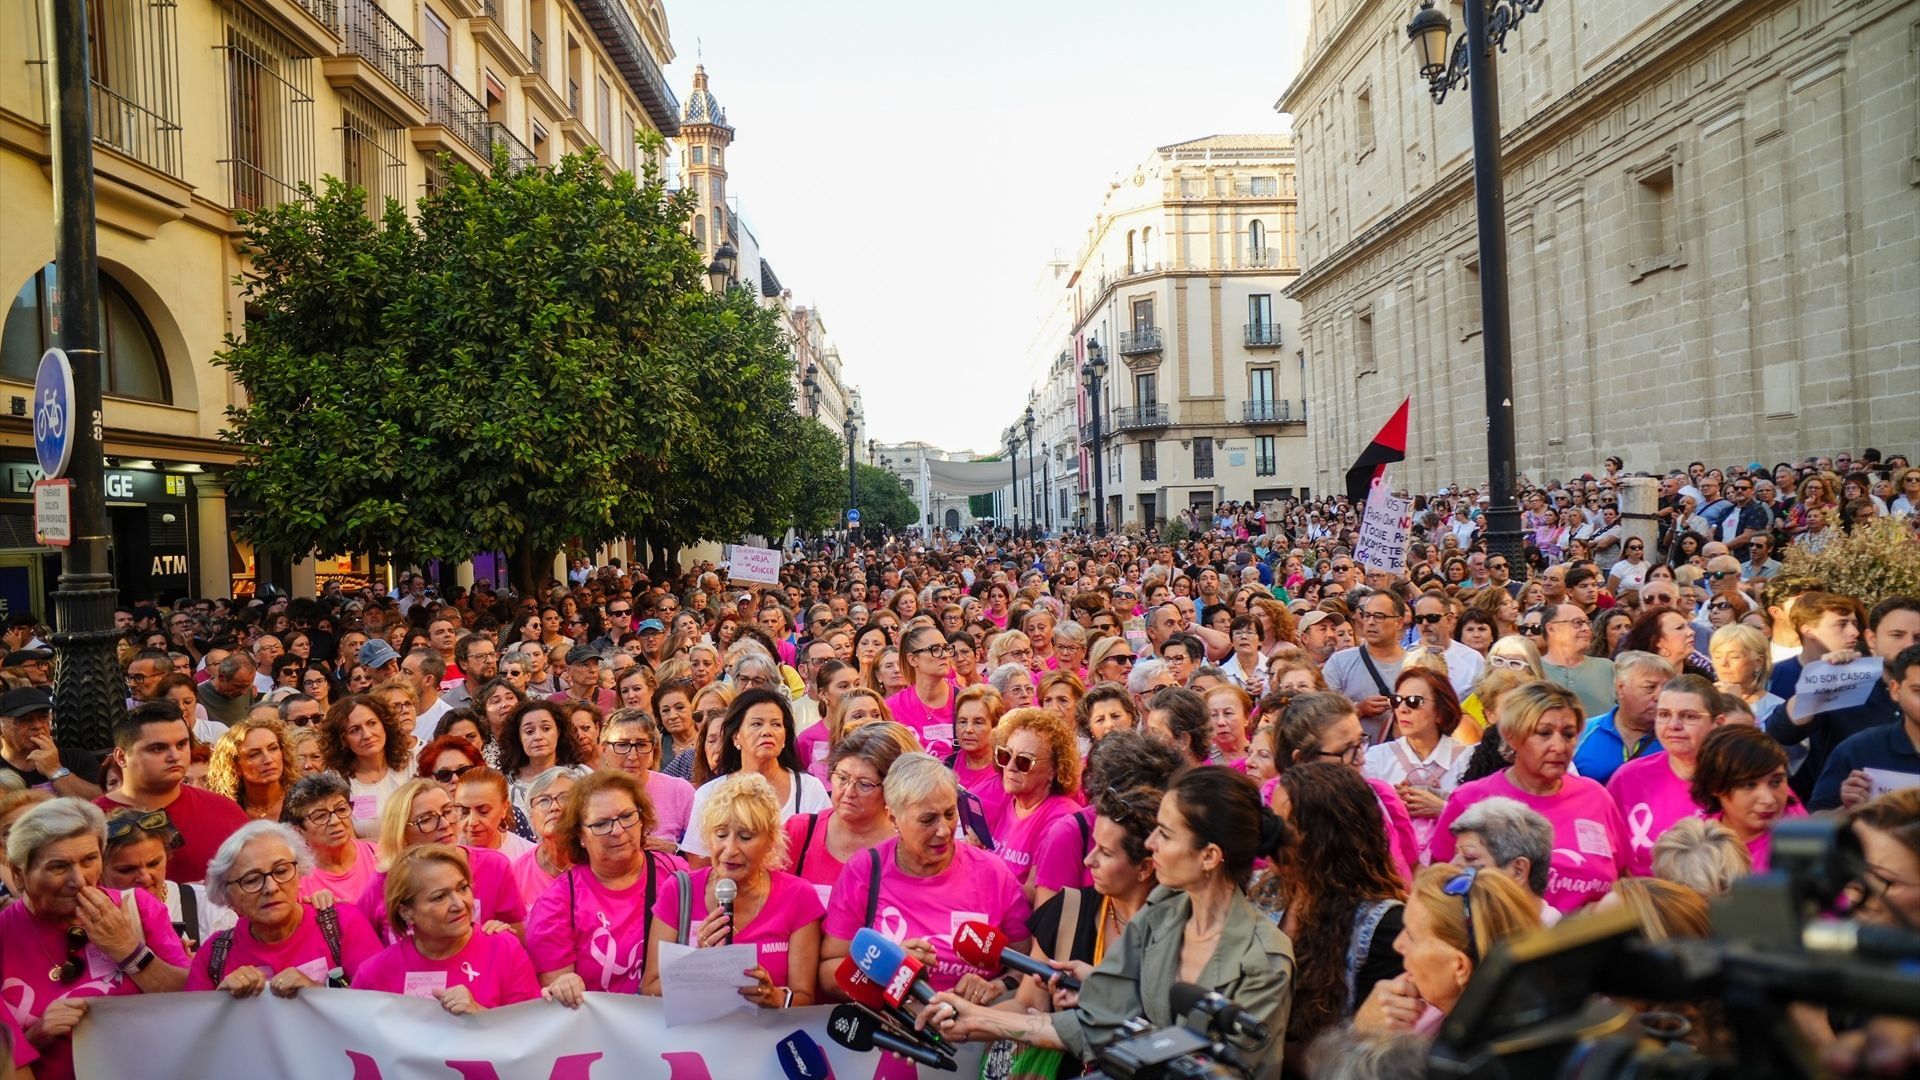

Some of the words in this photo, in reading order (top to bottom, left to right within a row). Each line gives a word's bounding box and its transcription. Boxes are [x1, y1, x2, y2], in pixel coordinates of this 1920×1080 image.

[152, 555, 188, 576] ATM
[1805, 675, 1818, 684] NO
[1820, 674, 1838, 683] SON
[959, 924, 984, 949] 7
[860, 944, 881, 970] tve
